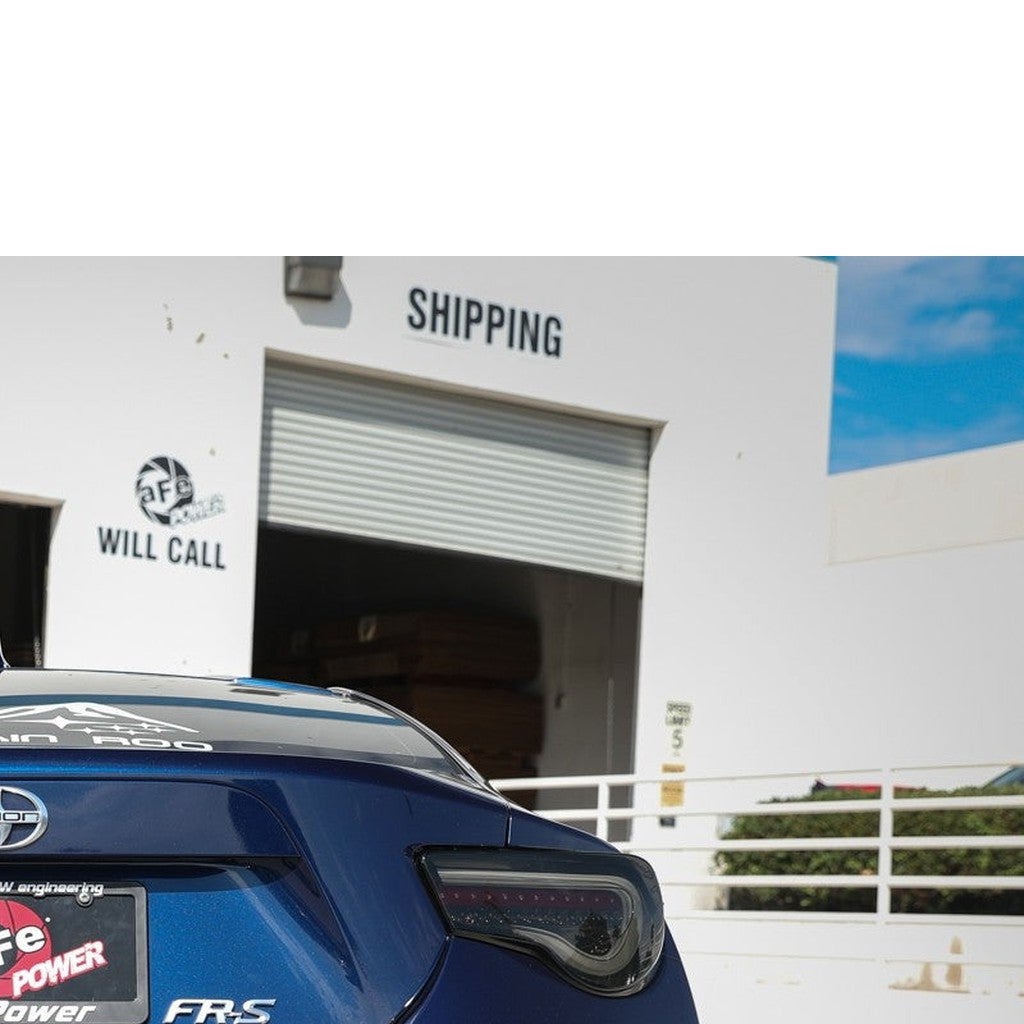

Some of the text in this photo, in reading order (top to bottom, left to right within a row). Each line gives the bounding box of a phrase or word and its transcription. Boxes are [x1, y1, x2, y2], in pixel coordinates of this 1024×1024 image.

[407, 286, 563, 358] SHIPPING
[139, 478, 192, 504] aFe
[98, 526, 227, 570] WILL CALL
[672, 729, 684, 750] 5
[17, 881, 105, 897] engineering
[12, 941, 107, 999] POWER
